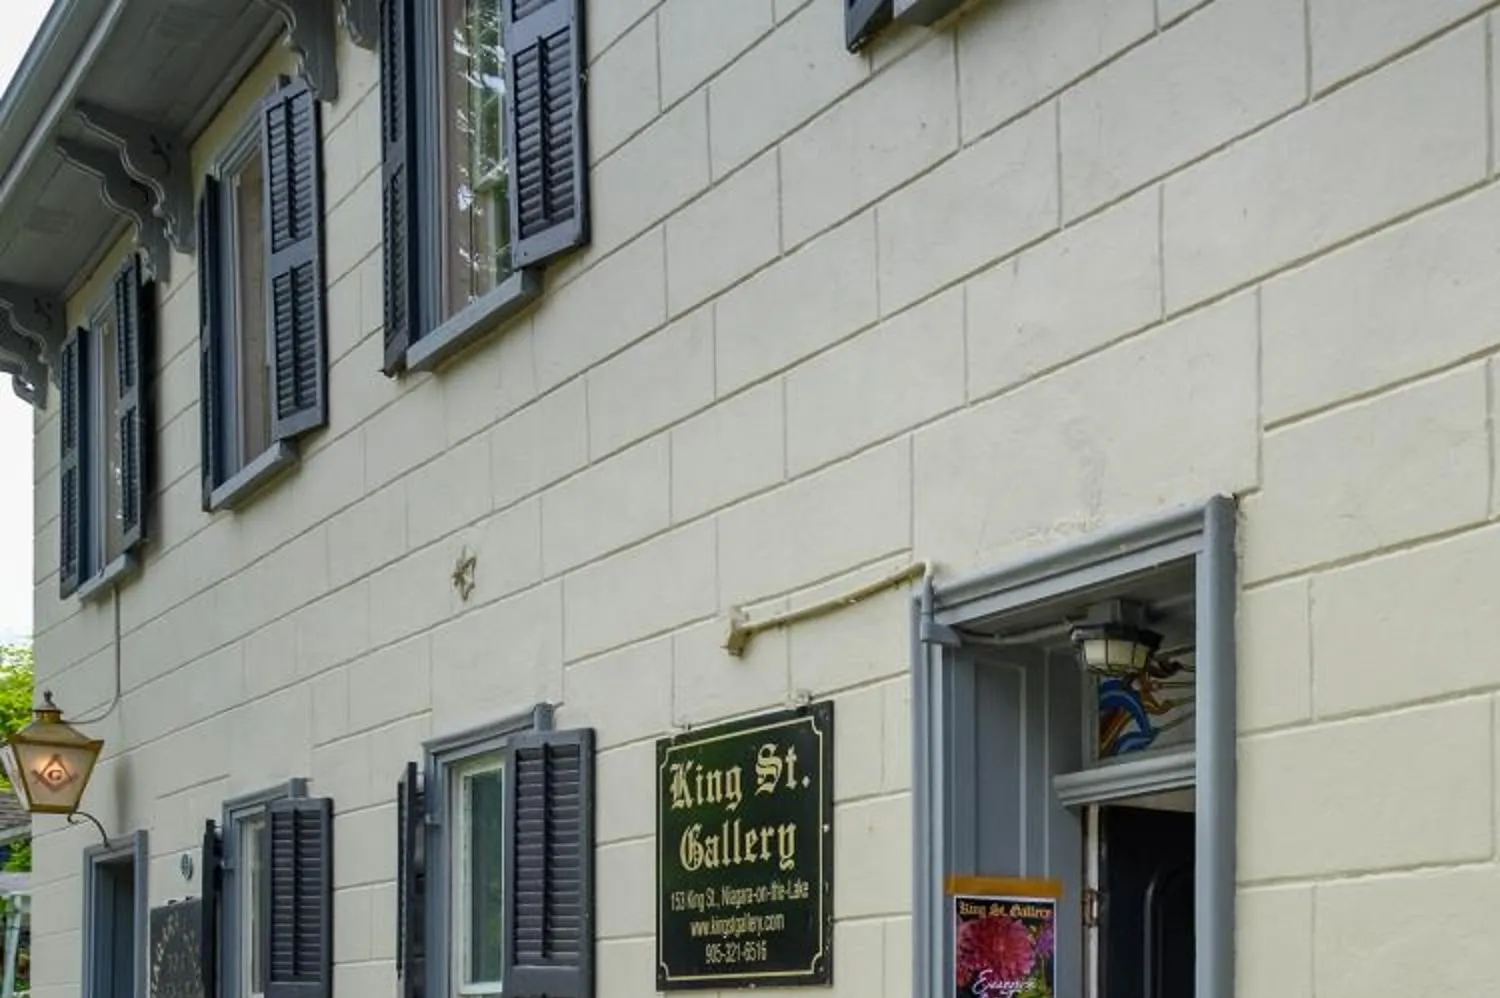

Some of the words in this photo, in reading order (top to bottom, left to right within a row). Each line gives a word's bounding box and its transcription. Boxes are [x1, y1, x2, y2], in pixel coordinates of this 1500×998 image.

[669, 760, 743, 811] King
[754, 743, 811, 796] St.
[679, 817, 797, 871] Gallery
[671, 891, 685, 911] 153
[687, 889, 705, 913] King
[721, 878, 809, 909] Niagara-on-the-Lake
[960, 902, 987, 918] King
[1010, 904, 1053, 919] Gallery
